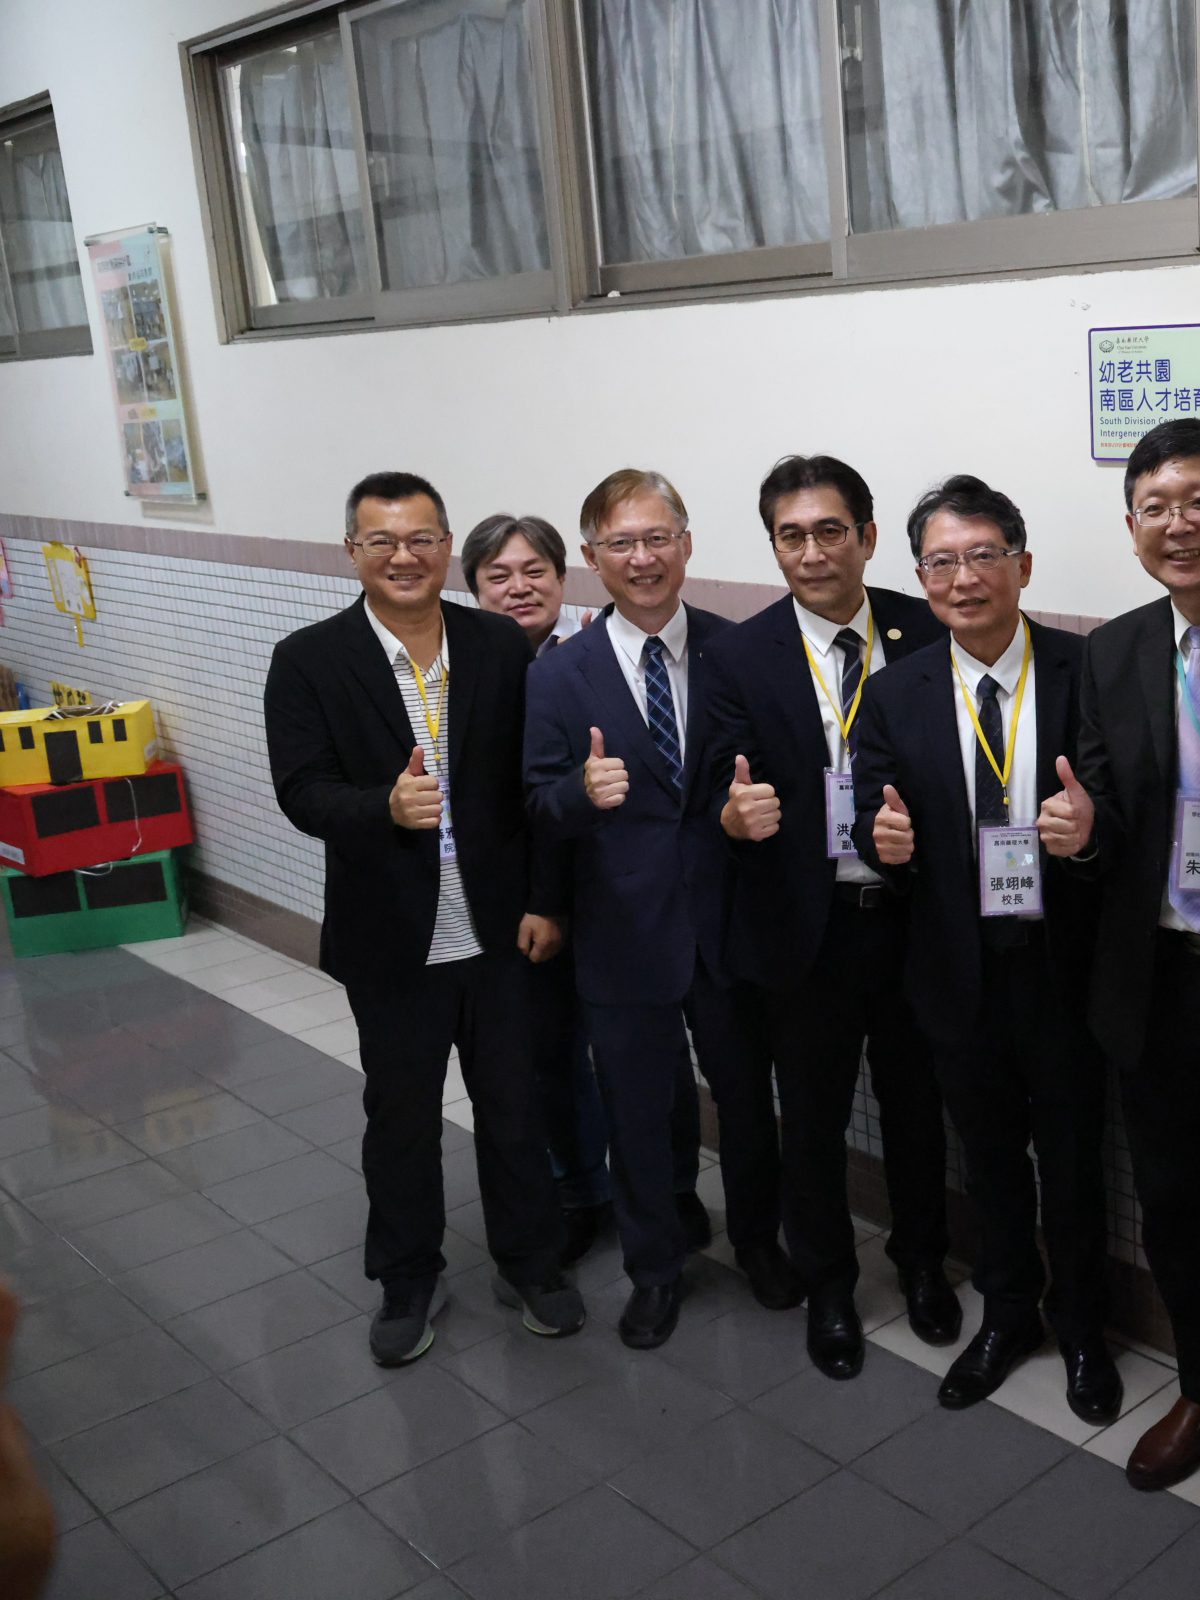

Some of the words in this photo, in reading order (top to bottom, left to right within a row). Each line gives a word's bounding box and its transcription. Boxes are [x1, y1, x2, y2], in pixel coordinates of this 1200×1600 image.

[1099, 359, 1171, 383] 幼老共園
[1100, 416, 1123, 425] South
[1125, 416, 1156, 425] Division
[990, 876, 1034, 891] 張翊峰
[1001, 893, 1024, 905] 校長
